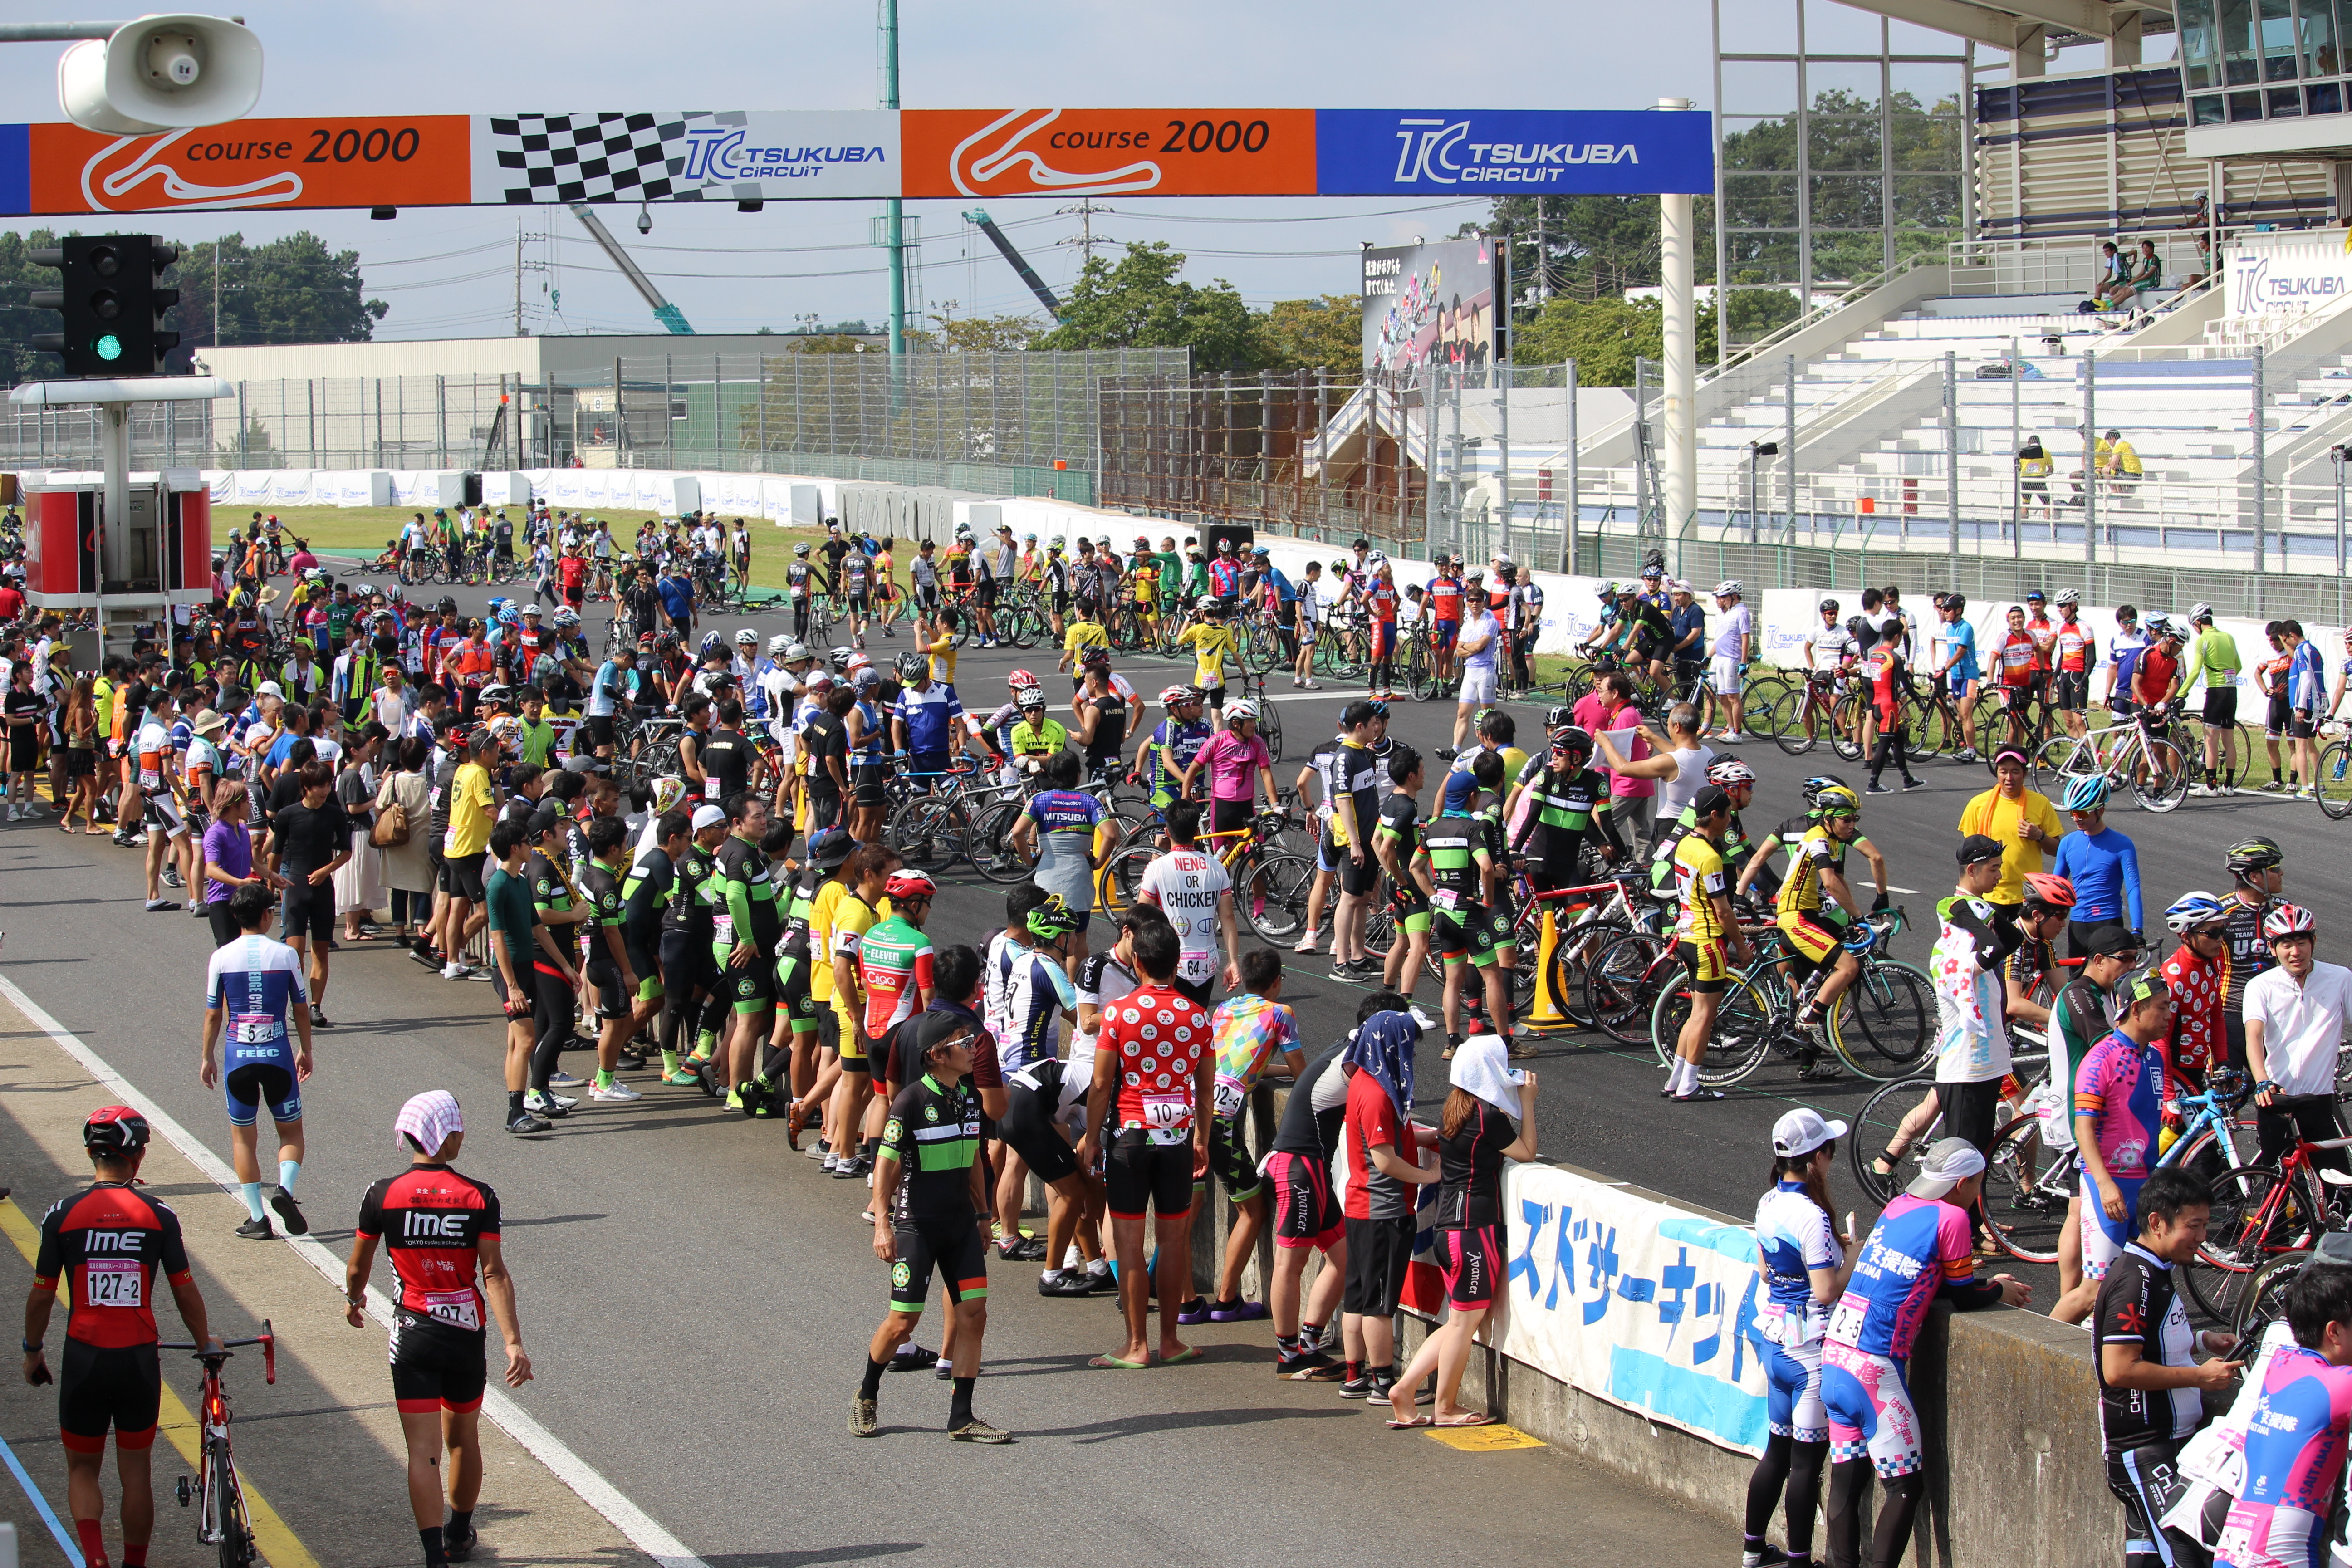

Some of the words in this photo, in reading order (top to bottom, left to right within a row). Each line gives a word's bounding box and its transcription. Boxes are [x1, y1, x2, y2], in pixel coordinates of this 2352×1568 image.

[186, 141, 292, 161] course
[302, 127, 420, 162] 2000
[1049, 135, 1150, 154] course
[1159, 124, 1269, 158] 2000
[745, 147, 885, 162] TSUKUBA
[1468, 143, 1639, 164] TSUKUBA
[1365, 258, 1401, 276] 筑波がボクらを
[1365, 279, 1398, 296] 育ててくれた。
[2269, 276, 2345, 296] TSUKUBA
[783, 727, 791, 757] MIRAIT
[248, 788, 262, 820] HITACHI
[1044, 813, 1088, 822] MITSUBA
[1175, 857, 1207, 872] NENG
[1186, 875, 1200, 888] OR
[1168, 890, 1219, 908] CHICKEN
[872, 929, 886, 937] Celeste
[882, 933, 897, 942] Cycles
[247, 950, 261, 970] EAST
[248, 971, 262, 992] EDGE
[1075, 957, 1088, 988] reric
[1879, 966, 1915, 980] CADENCE
[1766, 980, 1779, 1008] Bianchi
[2068, 989, 2083, 1014] WIZARD
[236, 1049, 279, 1058] FEEC
[2086, 1039, 2118, 1094] HASUDA
[1153, 1104, 1187, 1123] 10-4
[1294, 1184, 1309, 1231] Avancer
[1466, 1251, 1482, 1295] Avancer
[1868, 1244, 1923, 1279] 支援隊
[90, 1274, 139, 1299] 127-2
[1836, 1308, 1862, 1339] 2-5
[1897, 1290, 1927, 1348] SAITAMA
[1886, 1413, 1900, 1436] SAITAMA
[2260, 1410, 2300, 1432] 支援隊
[2299, 1440, 2335, 1495] SAITAMA
[2149, 1484, 2163, 1507] CYCLE
